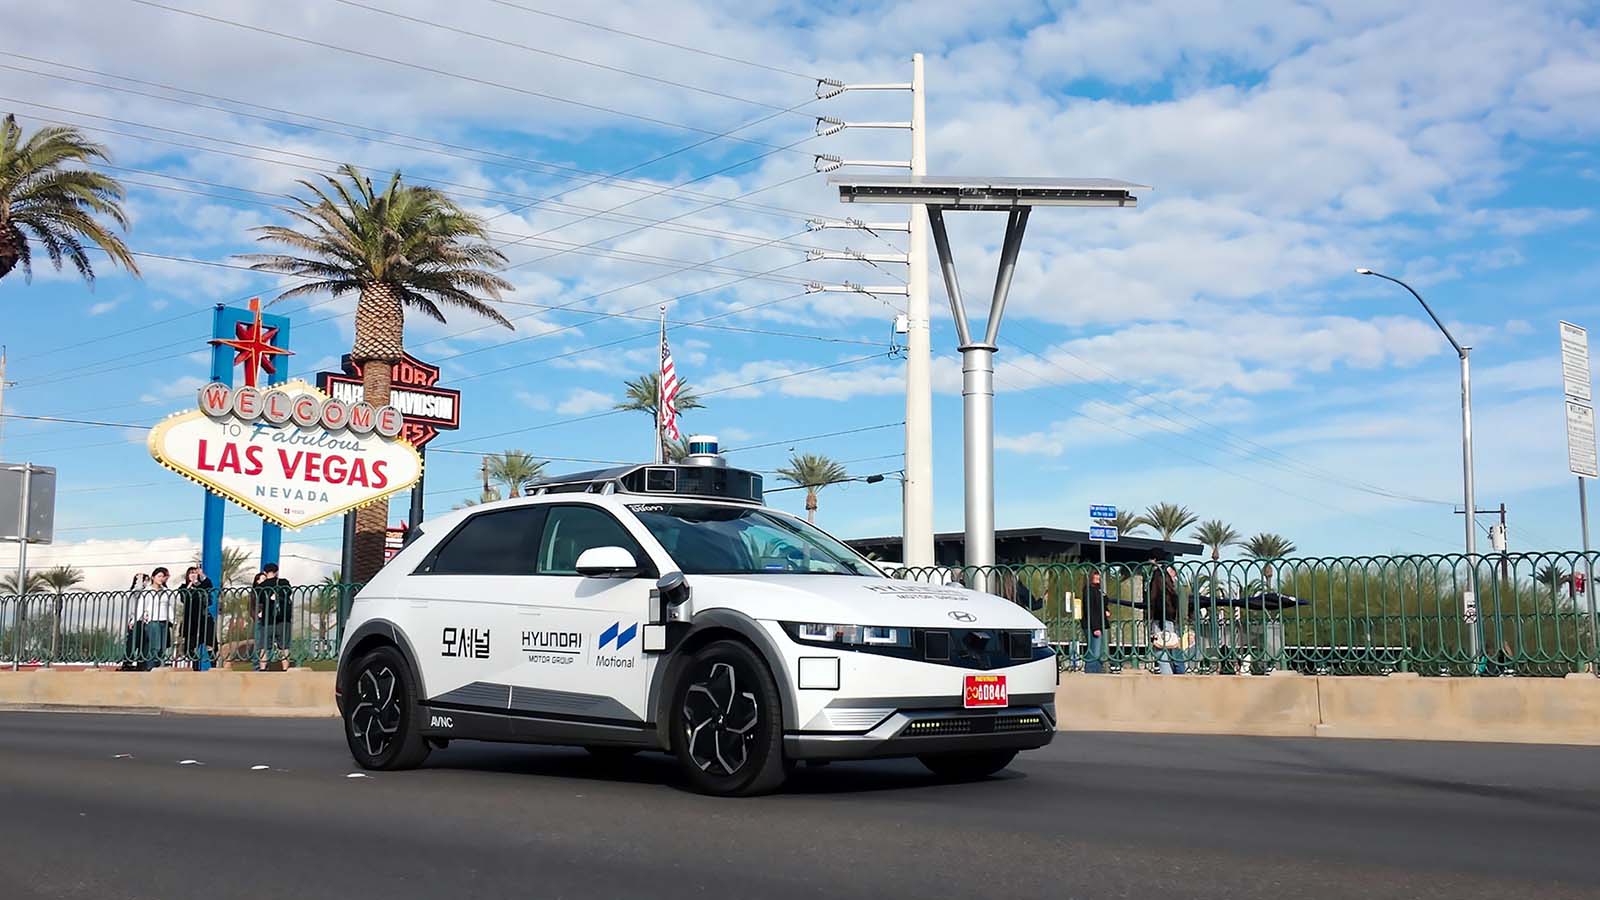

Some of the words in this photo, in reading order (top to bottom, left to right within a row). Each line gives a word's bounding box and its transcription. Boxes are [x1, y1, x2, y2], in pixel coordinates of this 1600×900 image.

[204, 389, 397, 432] WELCOME
[222, 423, 241, 437] TO
[250, 423, 367, 452] Fabulous
[198, 440, 263, 476] LAS
[278, 448, 388, 488] VEGAS
[256, 486, 329, 502] NEVADA
[442, 628, 490, 659] 모셔널
[522, 631, 582, 648] HYUNDAI
[529, 655, 550, 663] MOTOR
[552, 656, 573, 664] GROUP
[596, 655, 634, 668] Motional
[431, 716, 453, 728] AVNC
